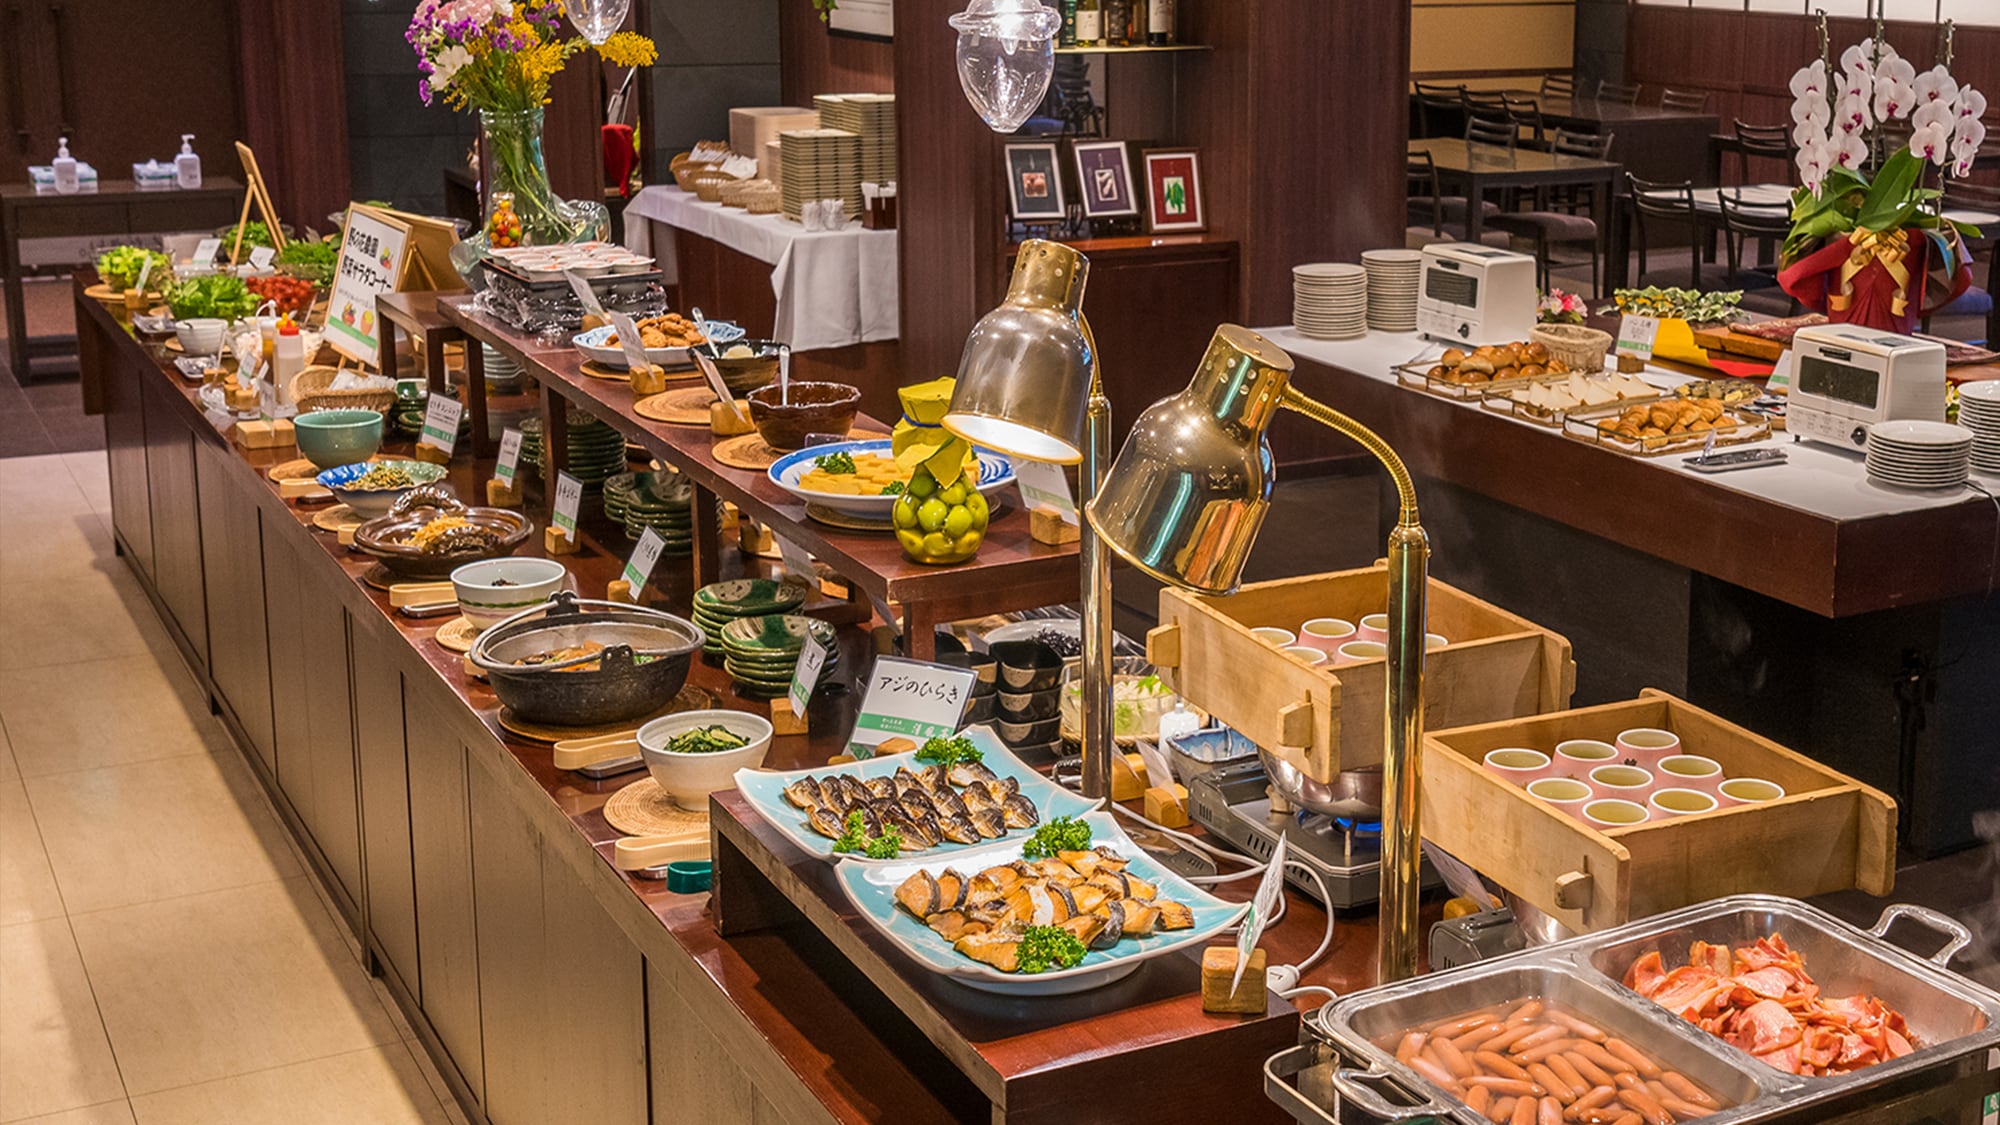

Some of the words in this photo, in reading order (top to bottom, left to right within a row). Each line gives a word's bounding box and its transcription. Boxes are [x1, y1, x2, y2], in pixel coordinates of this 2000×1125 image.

[341, 254, 392, 292] 野菜サラダコーナー
[879, 675, 959, 705] アジのひらき
